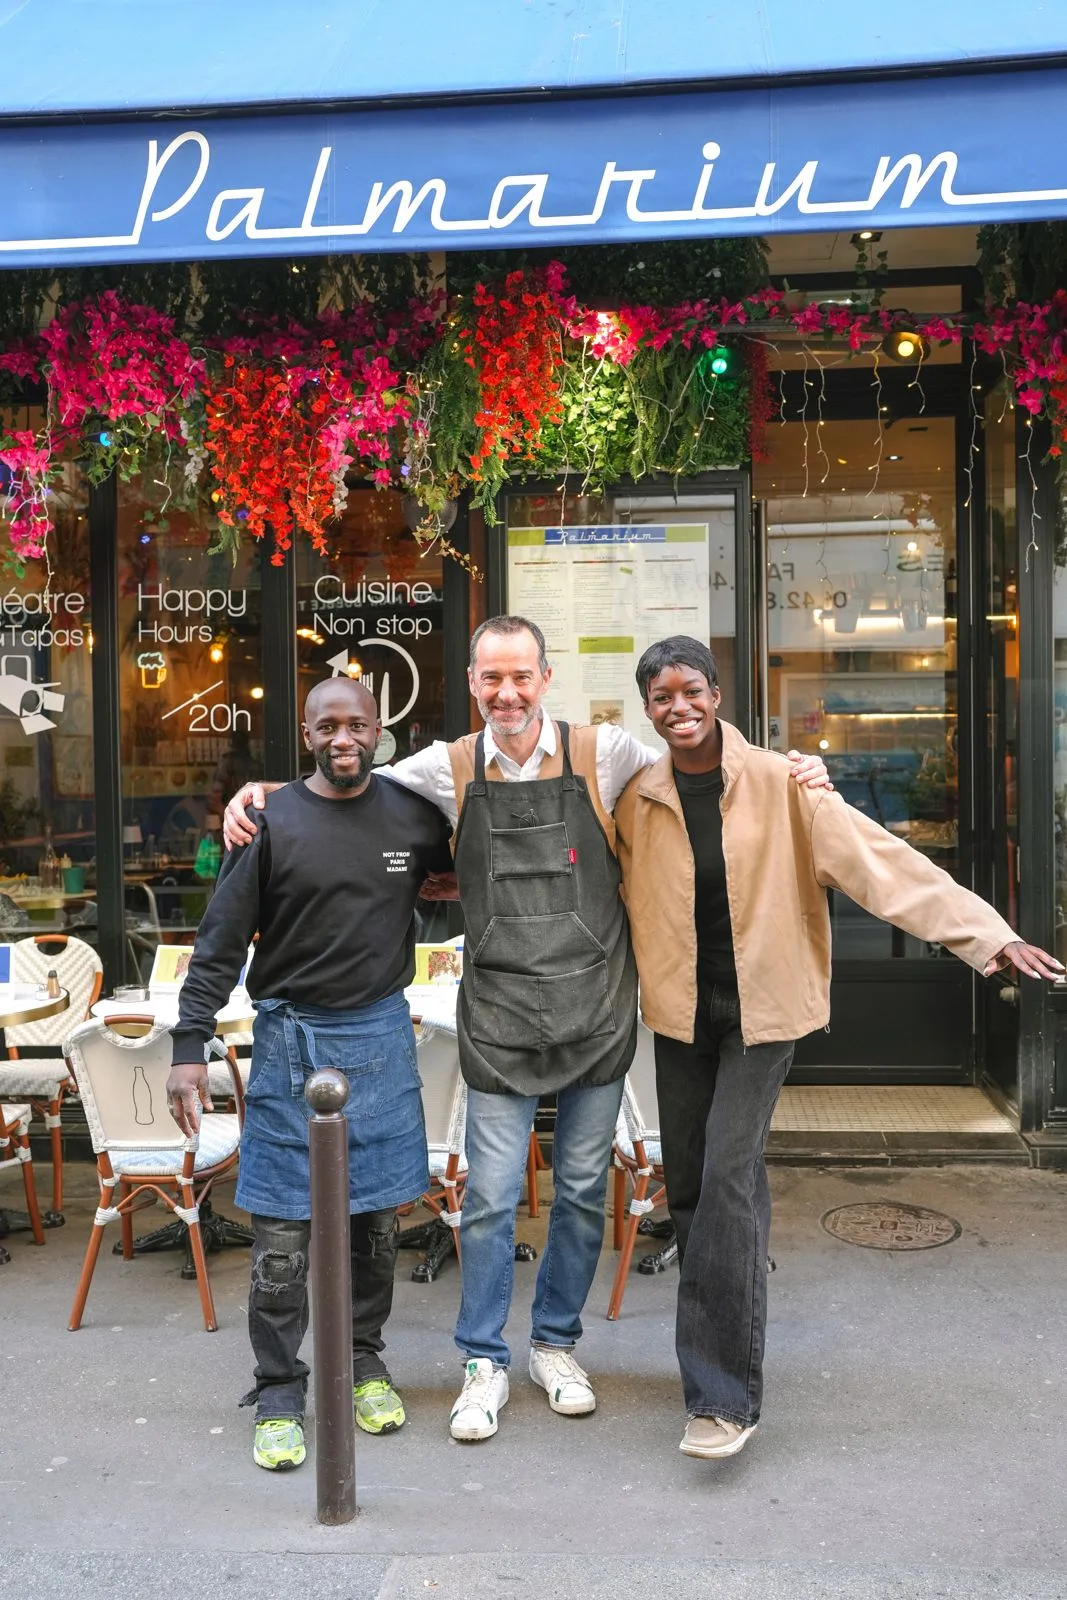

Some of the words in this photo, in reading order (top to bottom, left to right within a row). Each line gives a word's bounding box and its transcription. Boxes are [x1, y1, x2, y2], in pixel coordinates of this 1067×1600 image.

[130, 130, 960, 243] Palmarium
[138, 583, 246, 617] Happy
[314, 574, 433, 604] Cuisine
[138, 620, 213, 643] Hours
[313, 612, 366, 635] Non
[376, 614, 433, 640] stop
